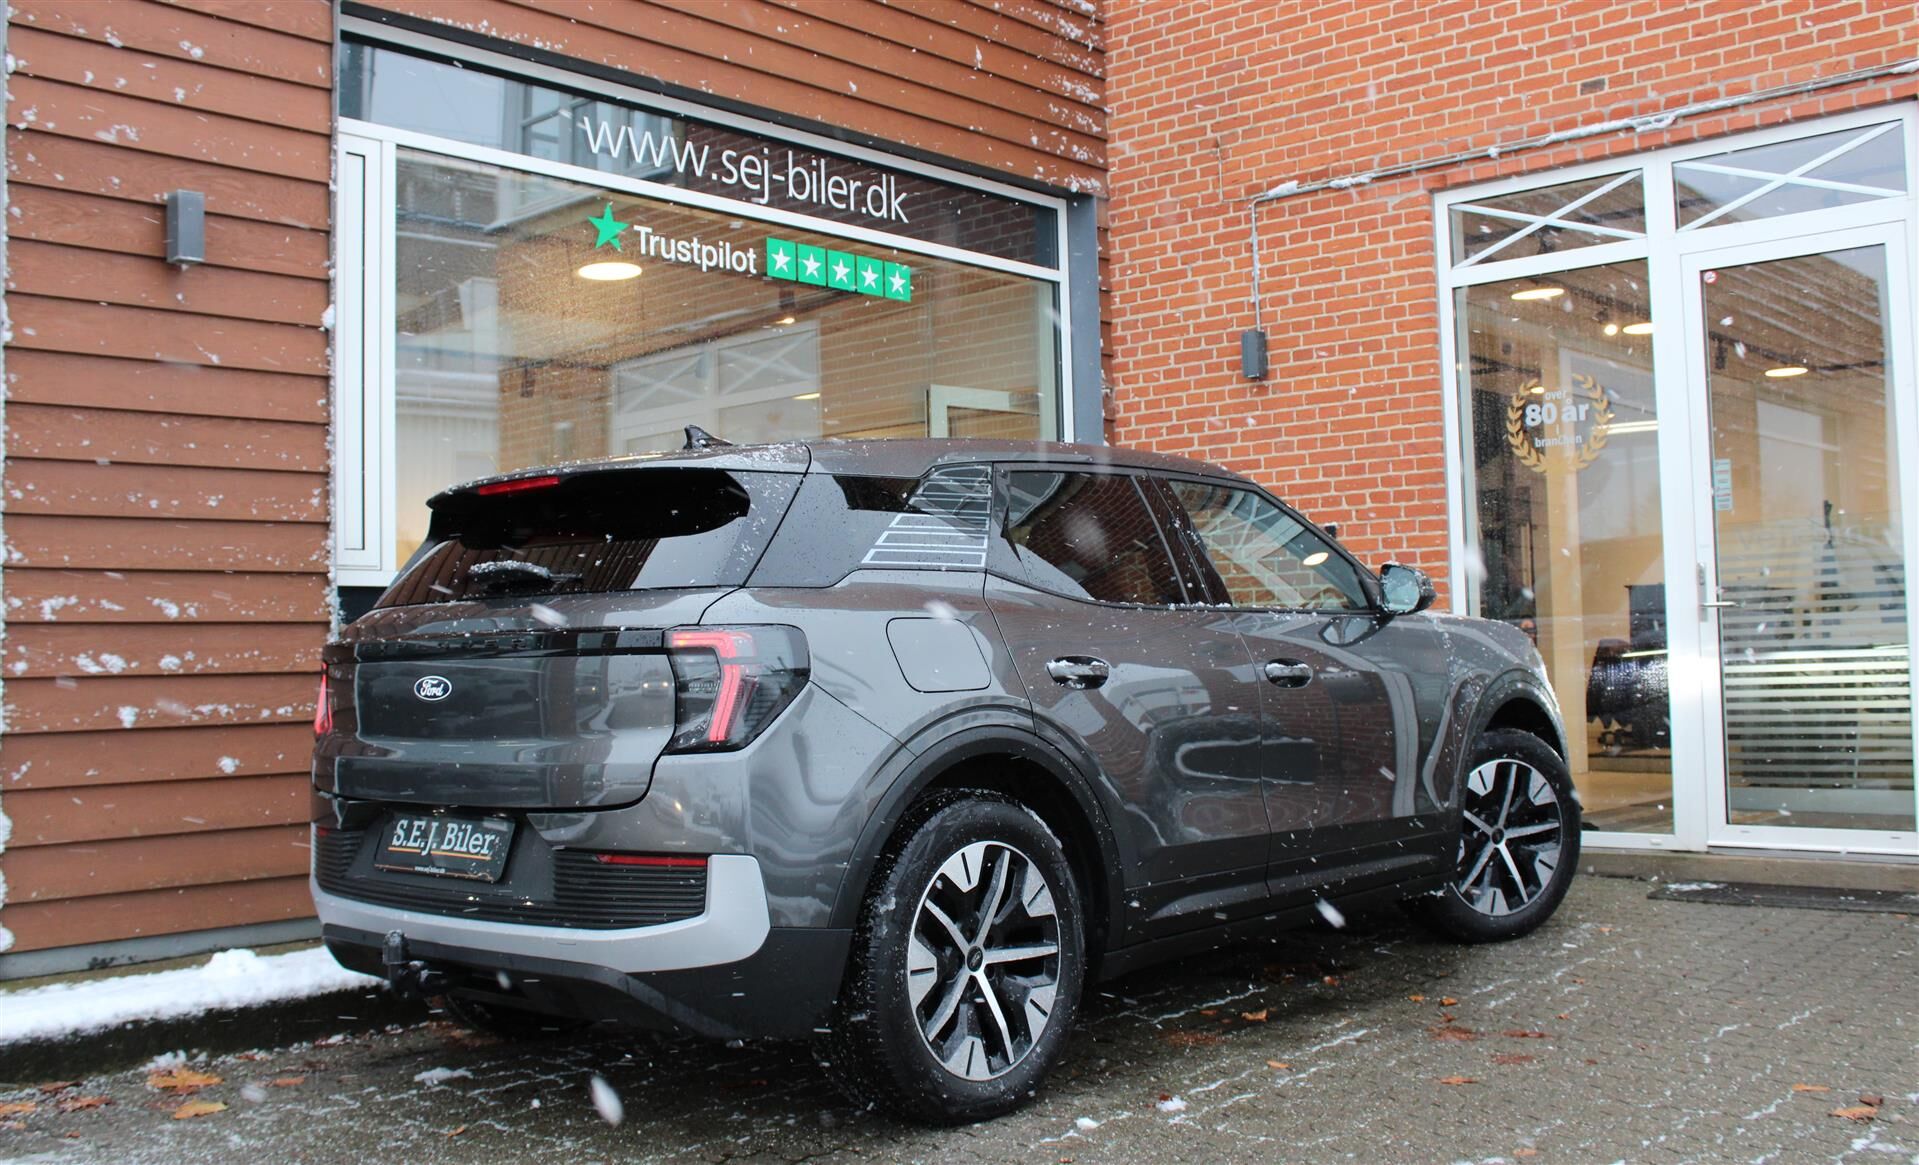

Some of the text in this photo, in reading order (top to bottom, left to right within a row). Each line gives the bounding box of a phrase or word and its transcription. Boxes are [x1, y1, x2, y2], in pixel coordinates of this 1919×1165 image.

[582, 115, 910, 223] www.sej-biler.dk
[633, 225, 757, 274] Trustpilot
[1525, 399, 1589, 427] 80 år
[1535, 434, 1583, 448] branchn
[420, 680, 444, 697] Ford
[392, 819, 495, 855] S.E.J. Biler
